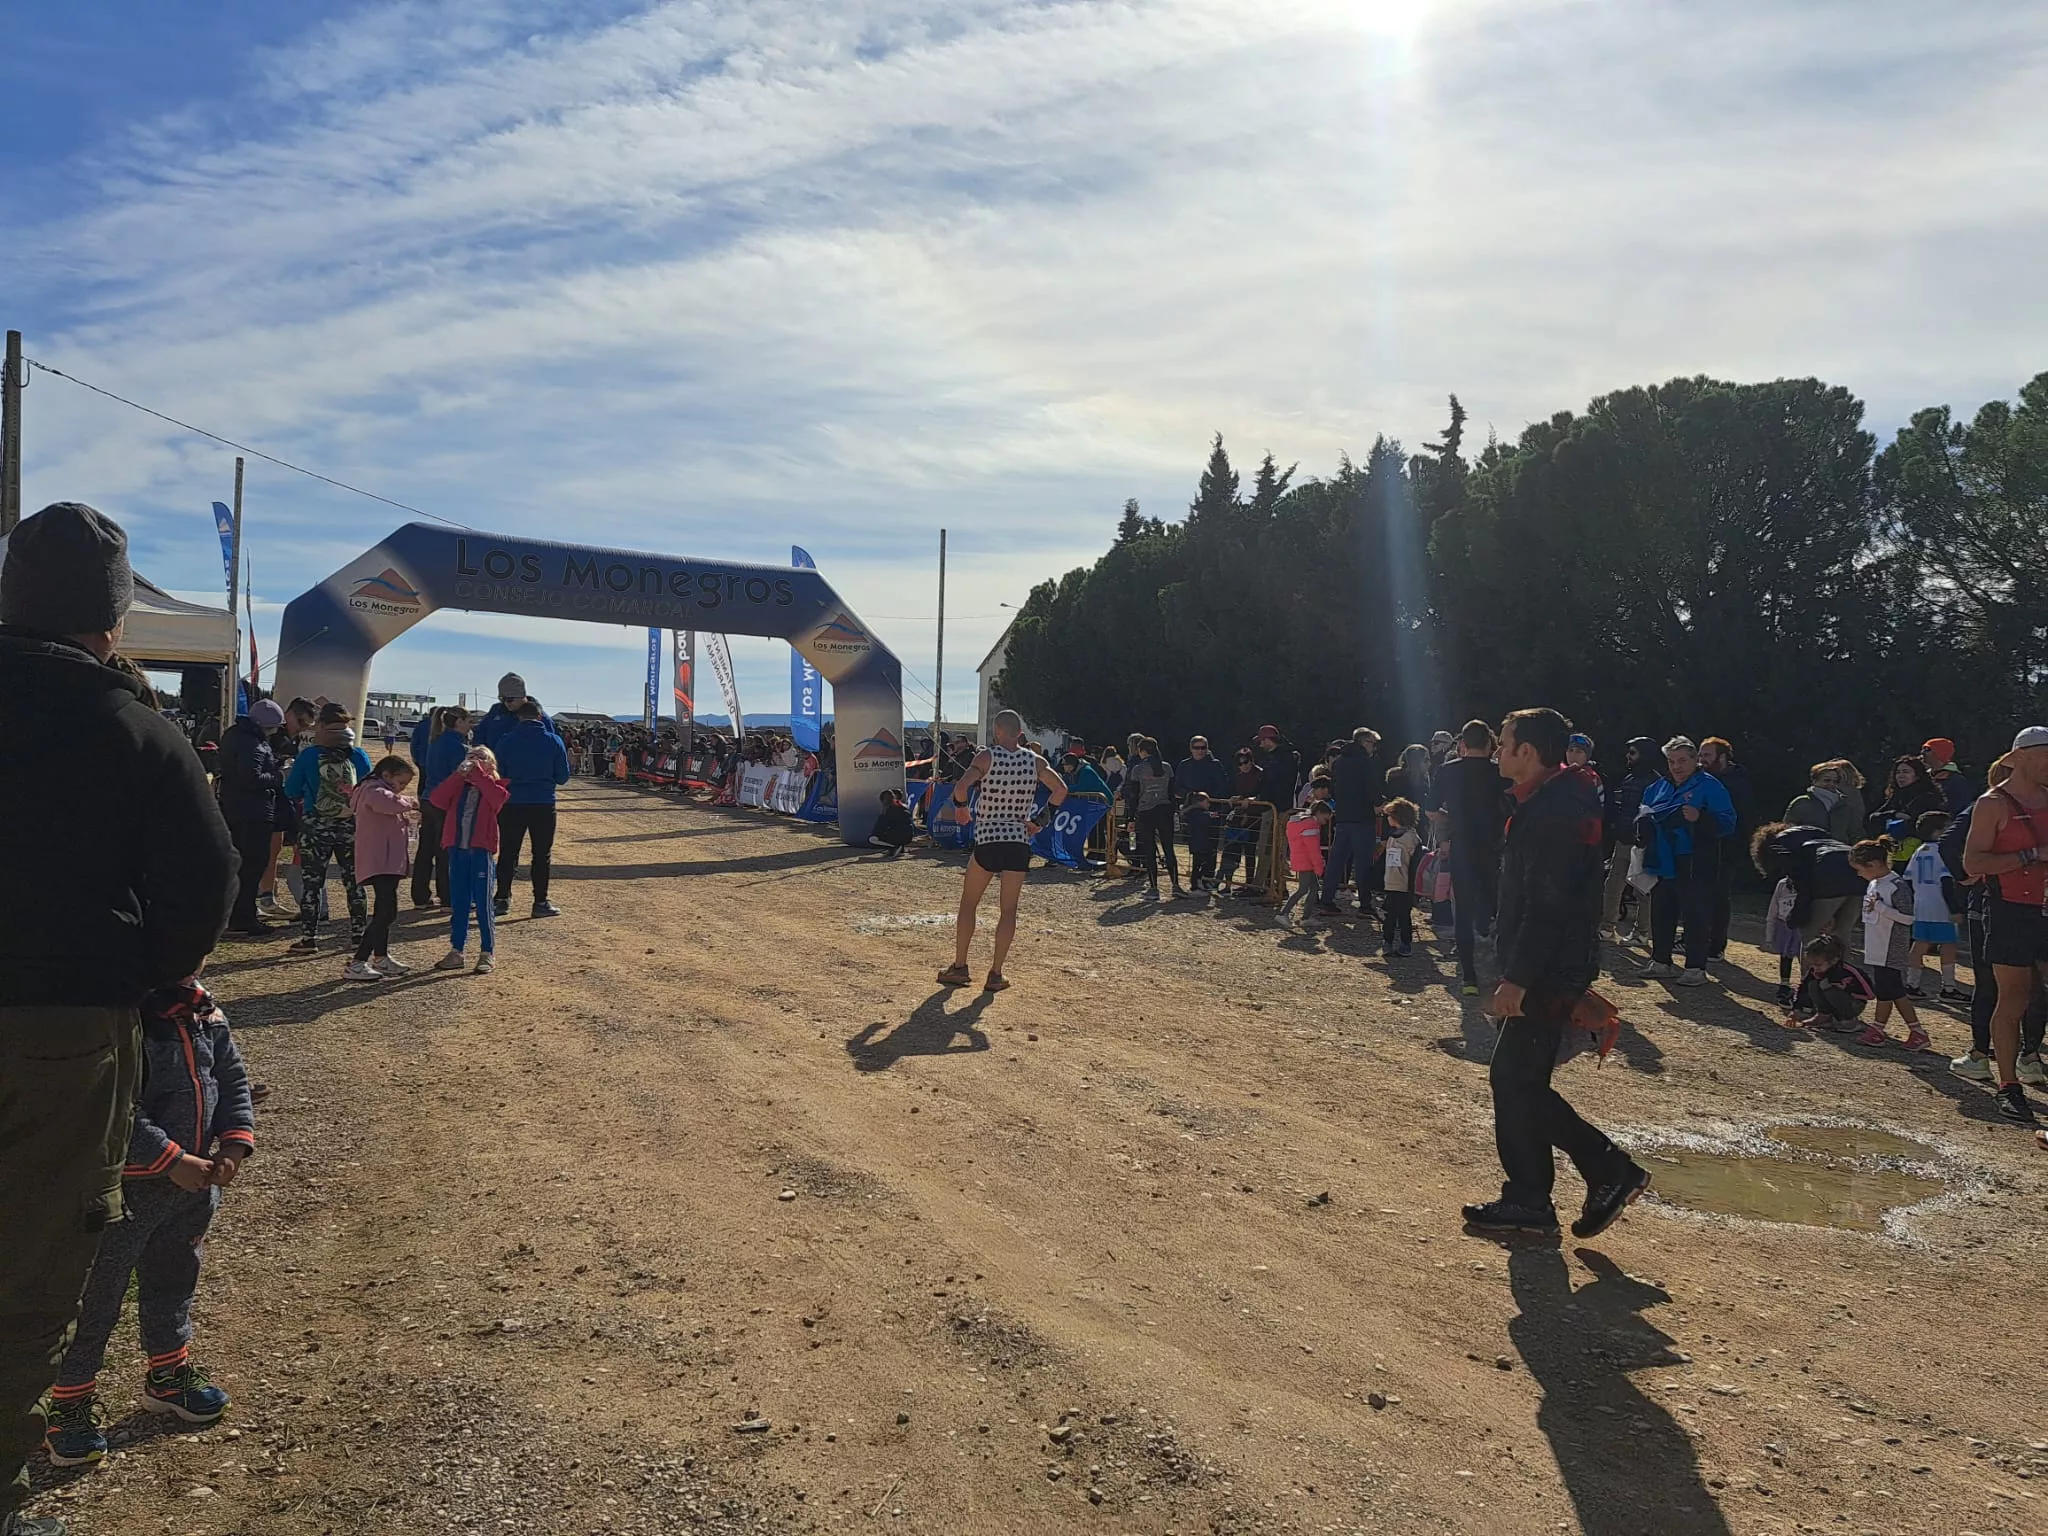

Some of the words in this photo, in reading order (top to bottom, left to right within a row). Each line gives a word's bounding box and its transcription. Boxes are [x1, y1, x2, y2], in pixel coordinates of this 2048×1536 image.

[456, 539, 543, 584] Los
[562, 552, 795, 609] Monegros
[349, 598, 368, 609] Los
[371, 601, 420, 615] Monegros
[454, 580, 563, 607] CONSEJO
[573, 593, 692, 619] COMARCAL
[813, 640, 828, 650] Los
[830, 643, 870, 652] Monegros
[854, 761, 869, 769] Los
[1916, 855, 1935, 884] 10
